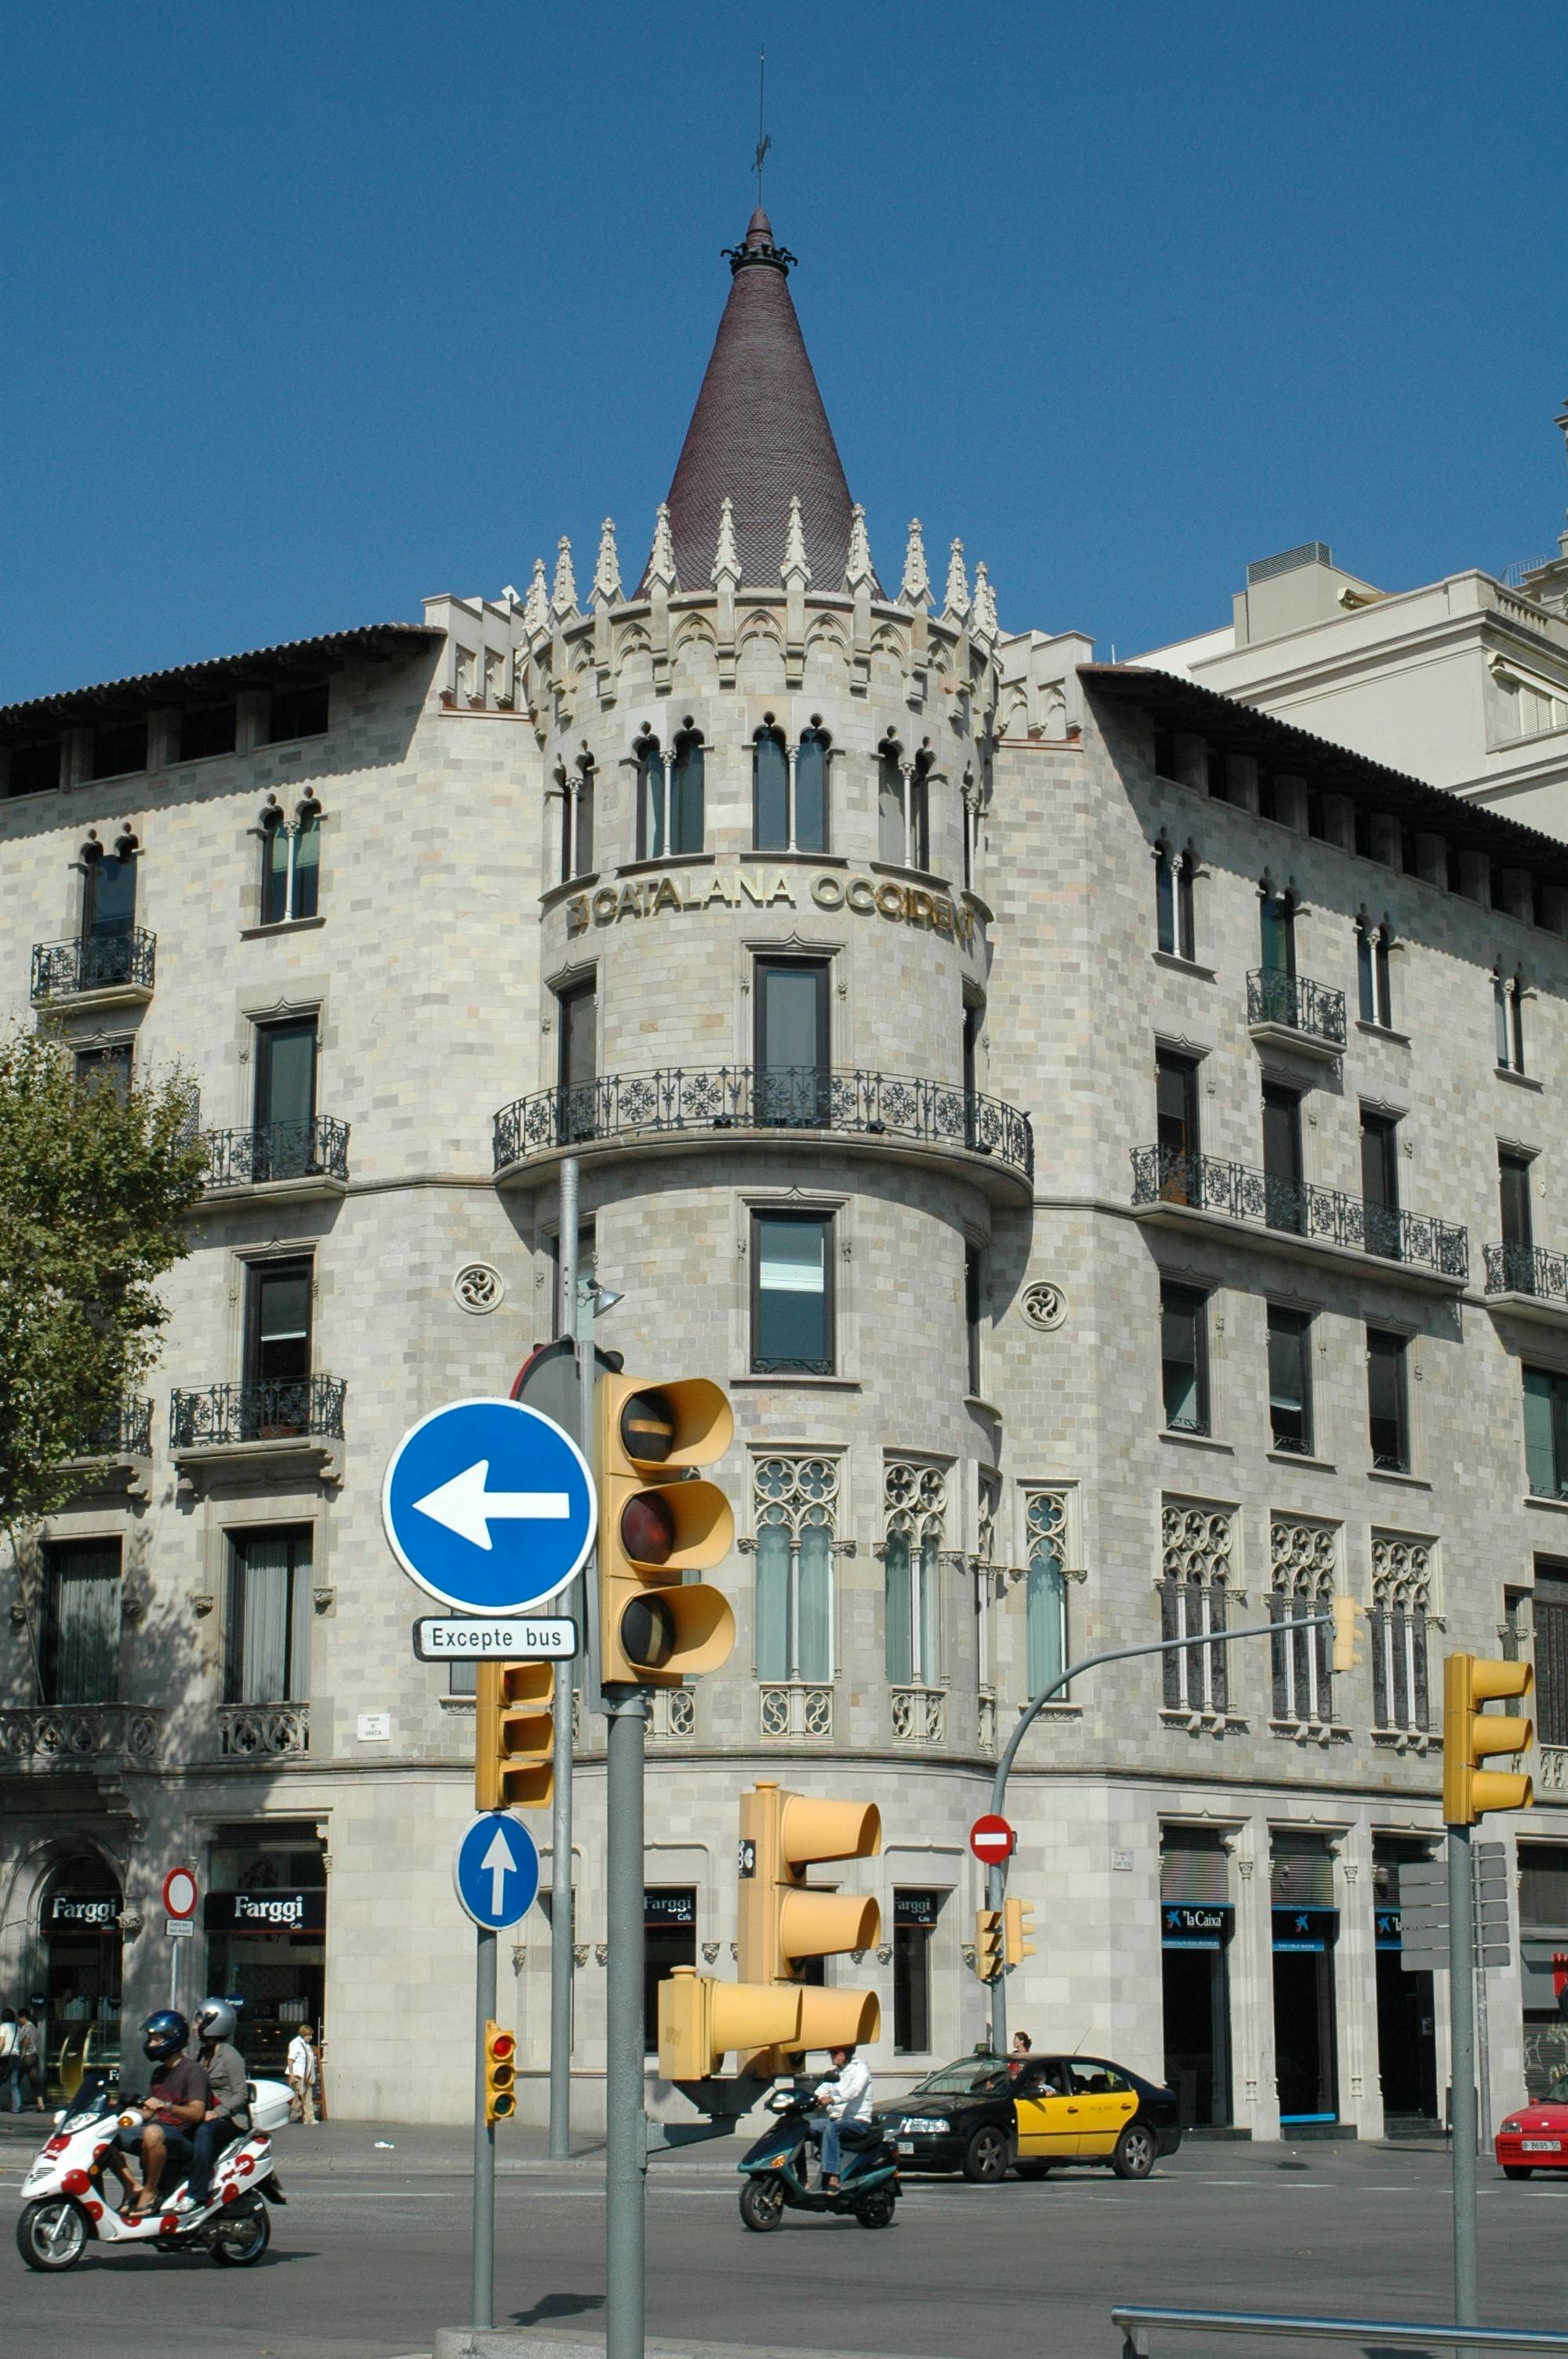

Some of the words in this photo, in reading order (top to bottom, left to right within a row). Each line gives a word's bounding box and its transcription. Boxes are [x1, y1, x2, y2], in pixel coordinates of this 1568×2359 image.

[591, 869, 797, 919] CATALANA
[433, 1627, 513, 1651] Excepte
[526, 1627, 561, 1646] bus
[52, 1897, 117, 1923] Farggi
[234, 1896, 303, 1922] Farggi
[644, 1896, 691, 1912] Farggi
[1182, 1910, 1195, 1926] "la
[1195, 1910, 1224, 1927] Caixa"
